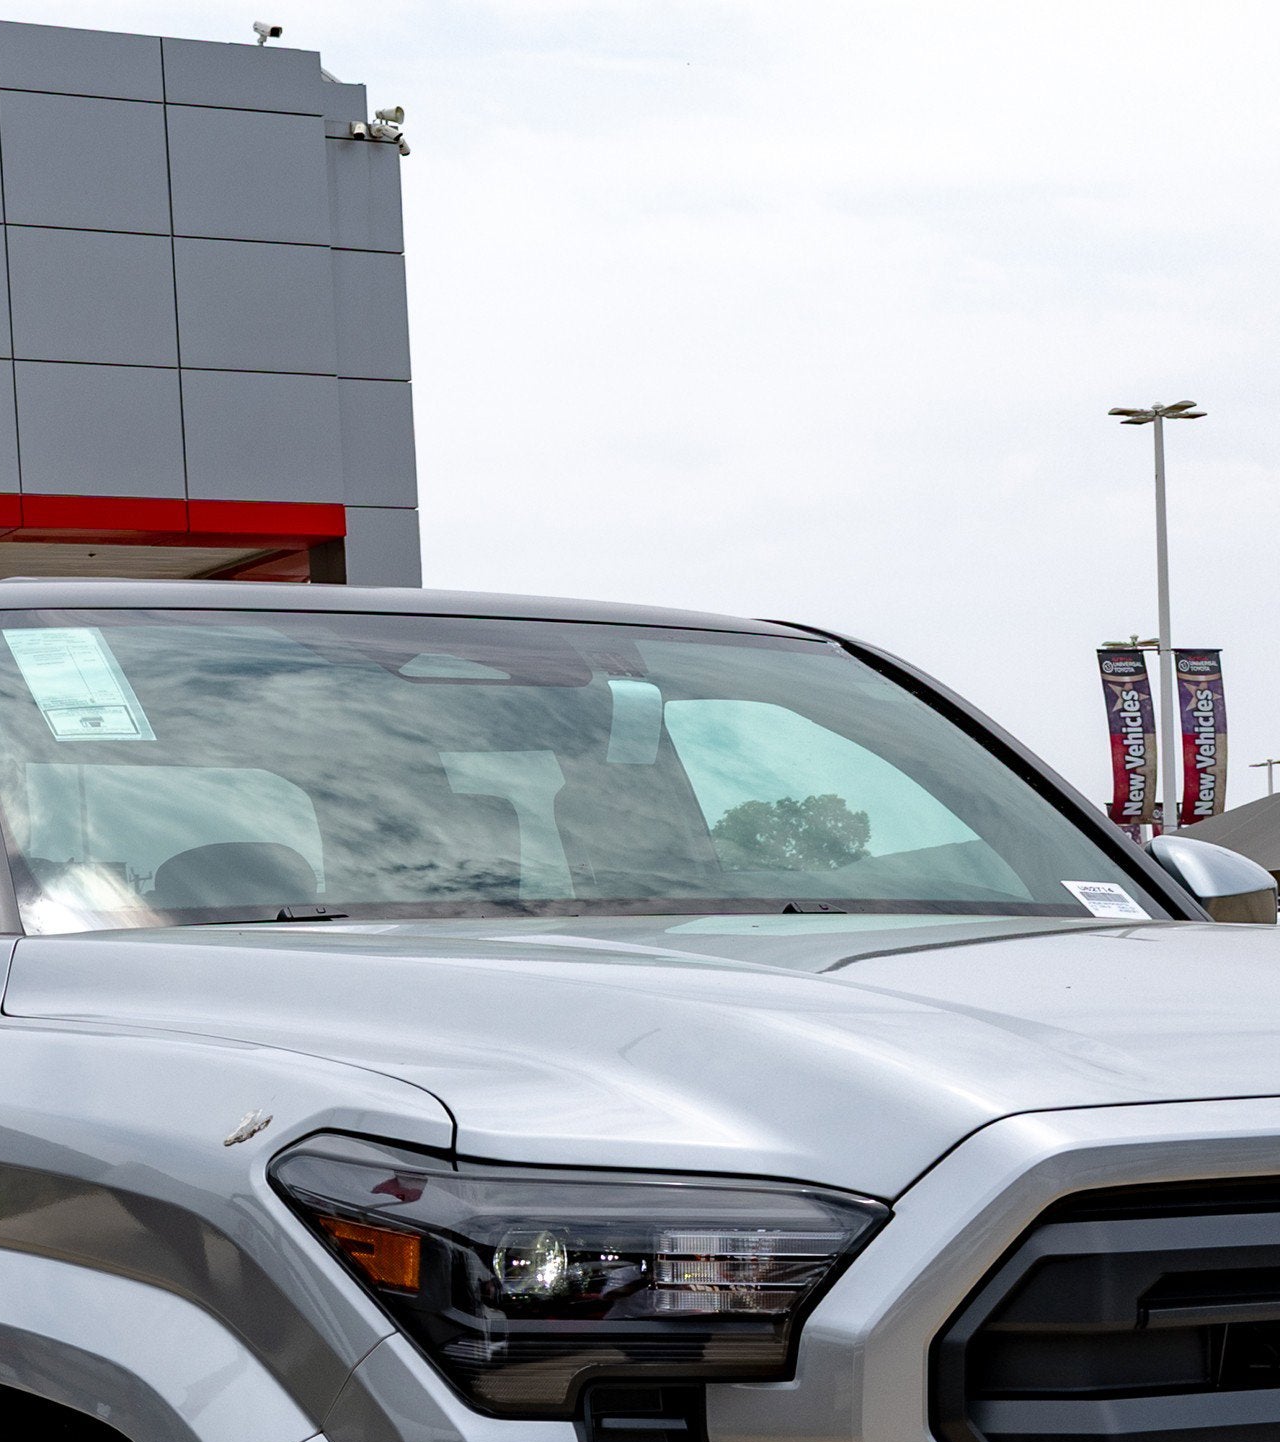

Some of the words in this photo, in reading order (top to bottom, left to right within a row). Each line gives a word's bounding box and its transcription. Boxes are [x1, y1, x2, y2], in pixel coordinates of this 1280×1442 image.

[1121, 690, 1145, 769] Vehicles
[1194, 689, 1215, 769] Vehicles
[1123, 774, 1145, 816] New
[1194, 774, 1215, 816] New
